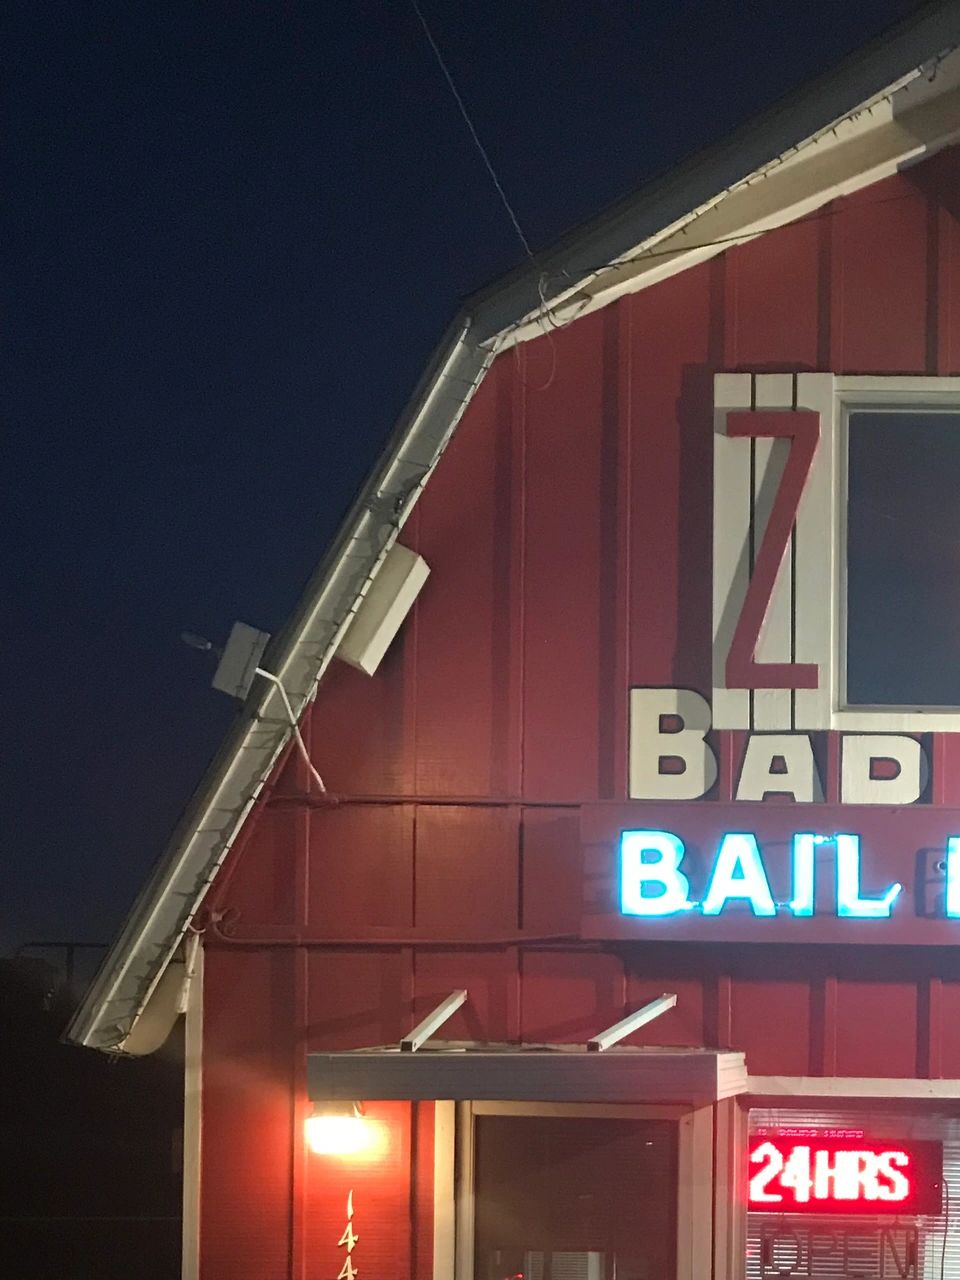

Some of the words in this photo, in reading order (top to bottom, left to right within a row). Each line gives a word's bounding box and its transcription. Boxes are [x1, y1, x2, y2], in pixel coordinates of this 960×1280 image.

[629, 687, 928, 806] BAD
[618, 830, 903, 918] BAIL
[748, 1141, 910, 1204] 24HRS
